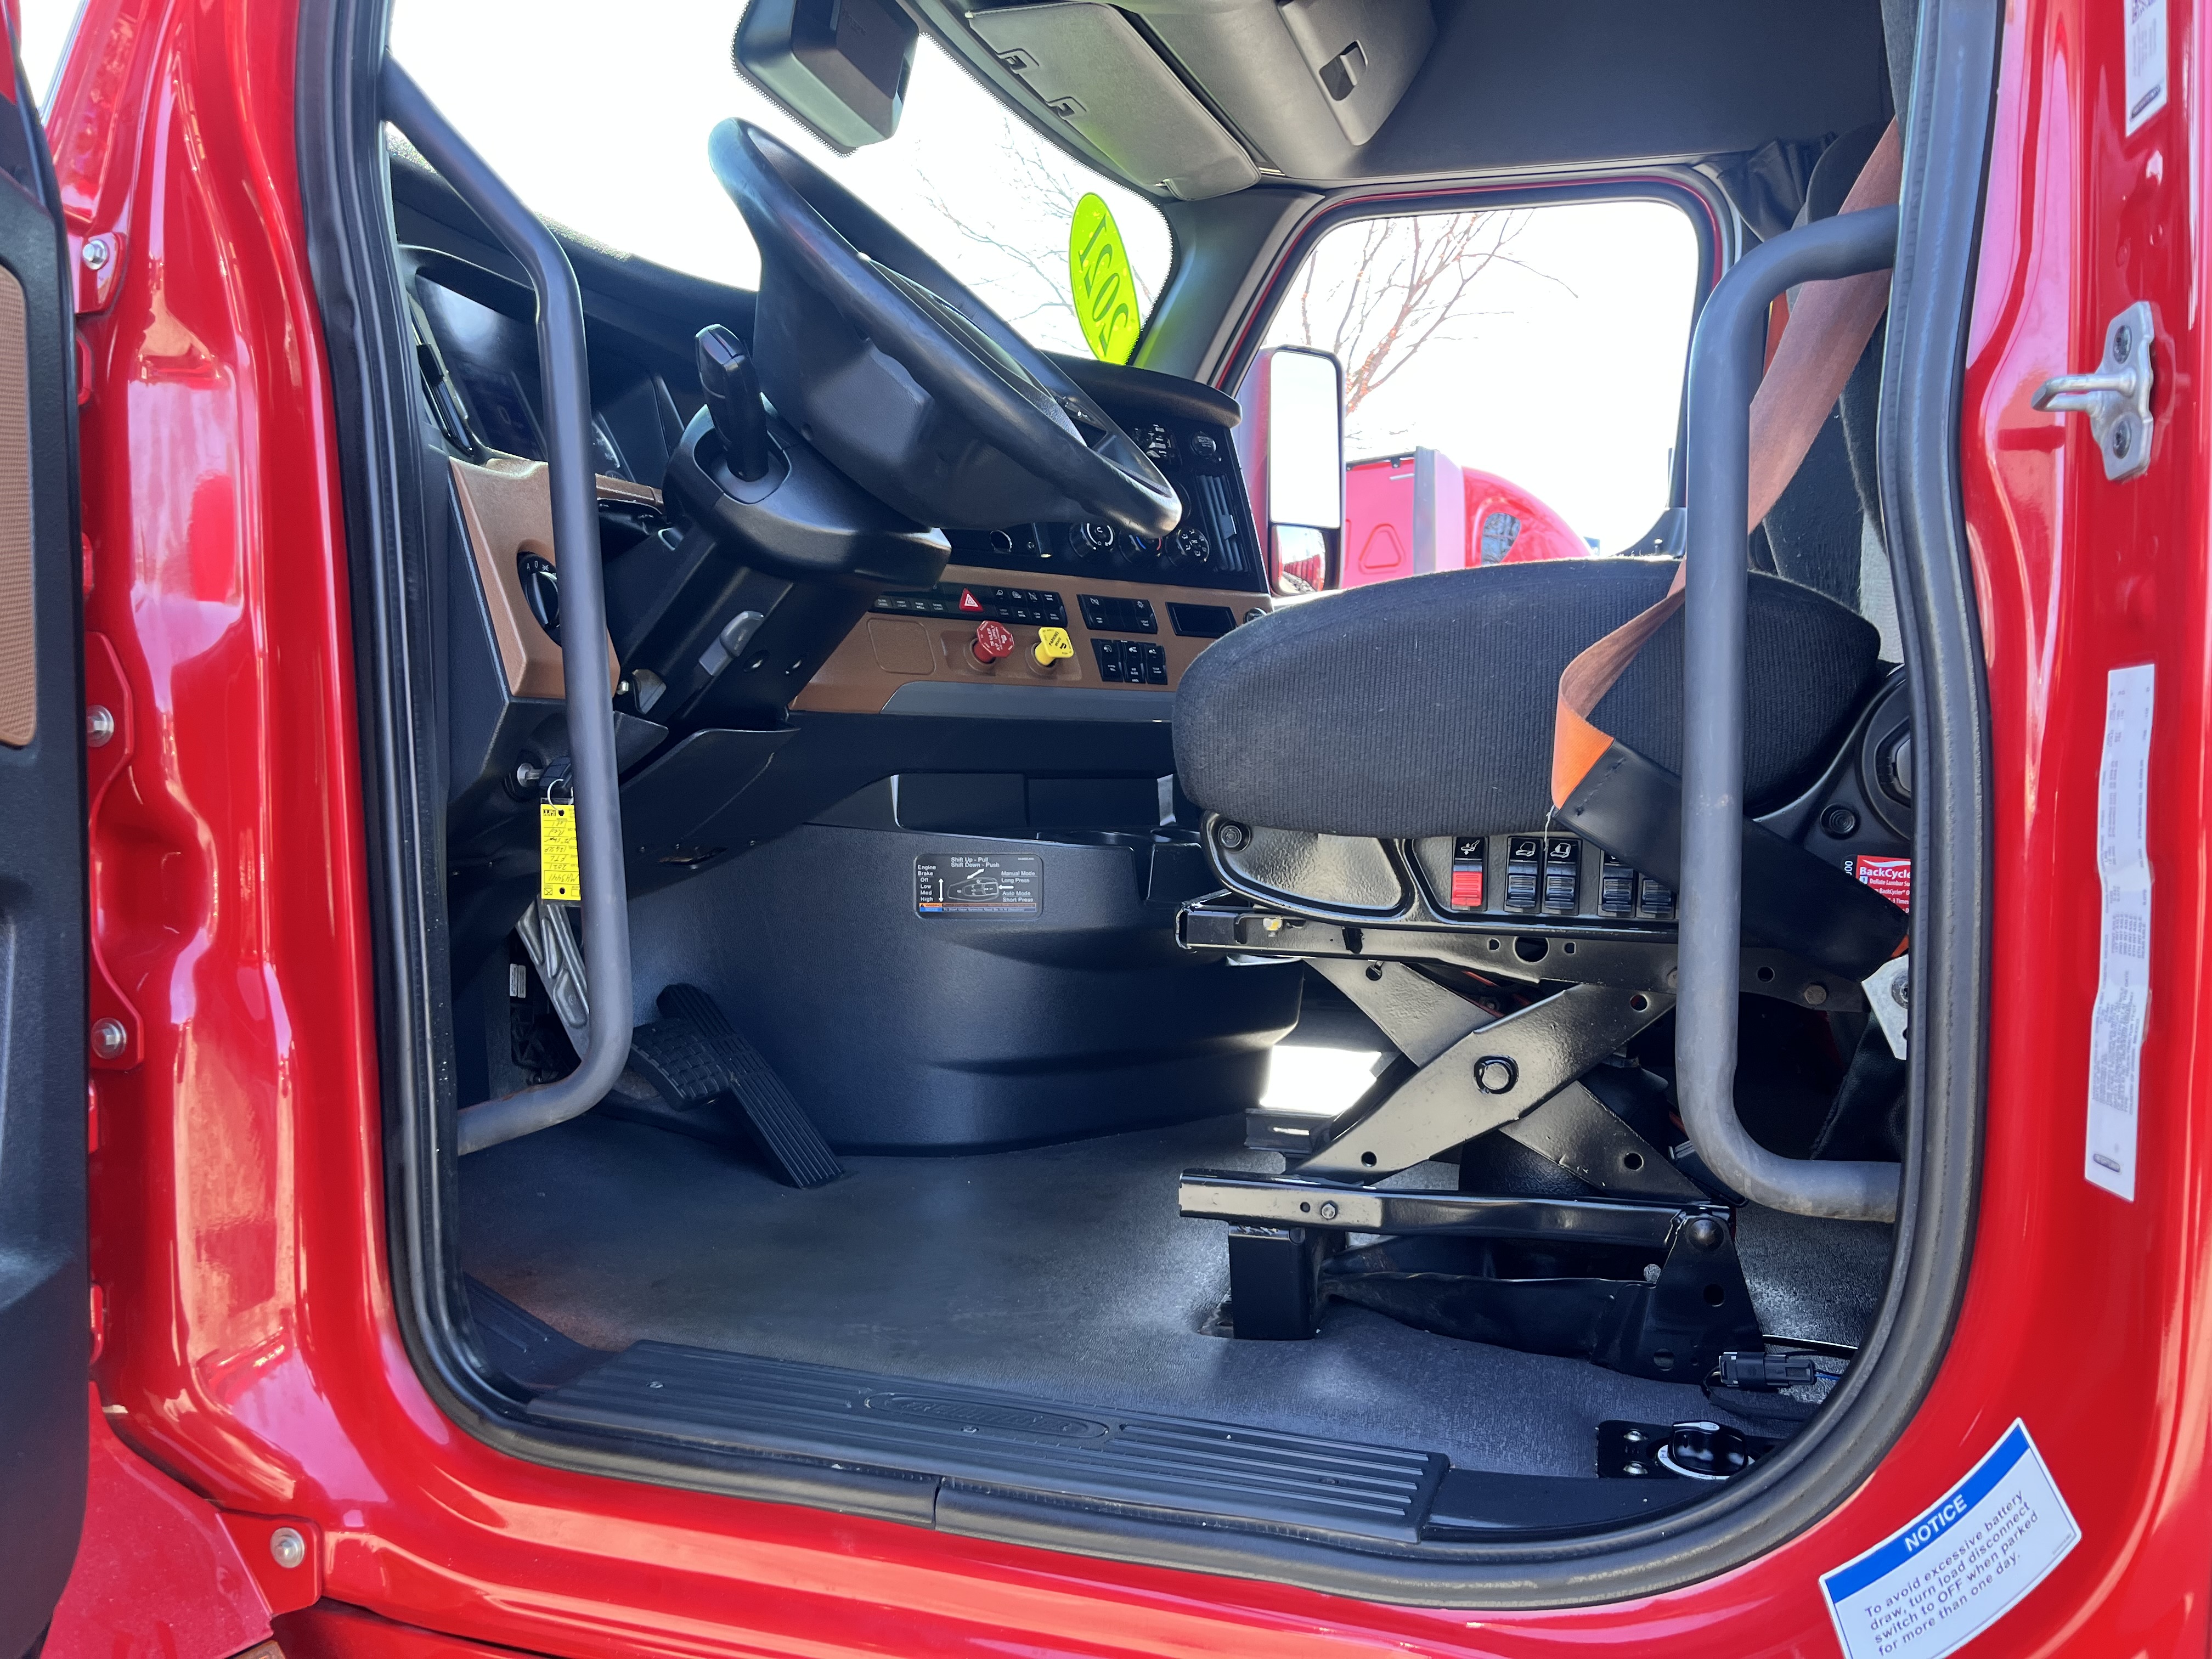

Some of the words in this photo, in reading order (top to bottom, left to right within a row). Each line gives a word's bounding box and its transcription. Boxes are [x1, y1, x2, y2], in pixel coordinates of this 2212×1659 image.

[1865, 1605, 1882, 1617] To
[1886, 1577, 1921, 1607] avoid
[1925, 1532, 1983, 1581] excessive
[1984, 1490, 2023, 1532] battery
[1871, 1607, 1906, 1630] draw,
[1909, 1585, 1936, 1607] turn
[1938, 1560, 1966, 1587] load
[1969, 1501, 2030, 1564] disconnect
[1875, 1612, 1918, 1643] switch
[1921, 1602, 1934, 1615] to
[1938, 1578, 1962, 1603] OFF
[1967, 1552, 1999, 1582] when
[2001, 1510, 2038, 1555] parked
[1903, 1494, 1967, 1552] NOTICE
[1878, 1640, 1897, 1657] for
[1903, 1618, 1935, 1643] more
[1939, 1595, 1967, 1619] than
[1971, 1575, 1993, 1596] one
[1996, 1551, 2020, 1575] day.
